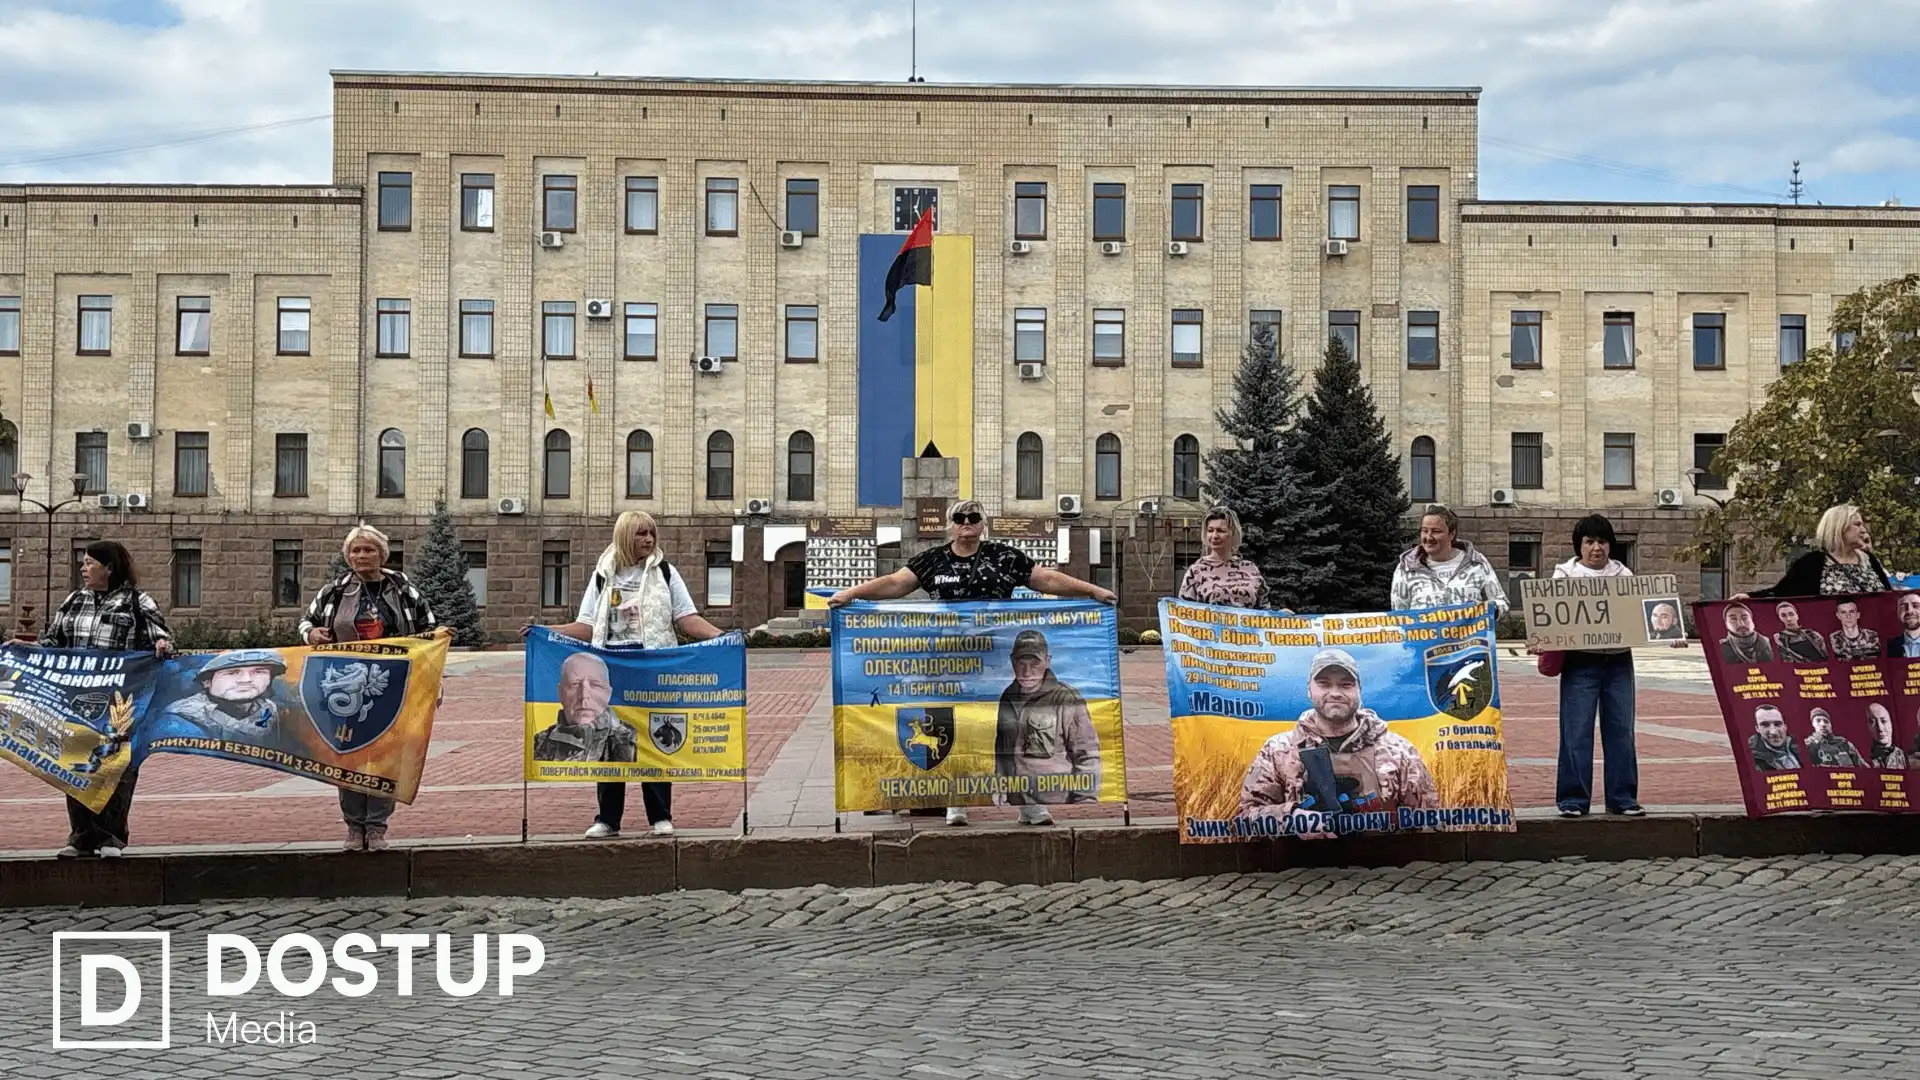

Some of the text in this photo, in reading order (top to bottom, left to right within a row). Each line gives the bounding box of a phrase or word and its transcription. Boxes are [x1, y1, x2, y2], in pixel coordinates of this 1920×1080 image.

[1524, 578, 1611, 599] НАЙБІЛЬША
[900, 611, 960, 628] ЗНИКЛИЙ
[975, 612, 990, 626] НЕ
[994, 612, 1046, 626] ЗНАЧИТЬ
[1168, 602, 1238, 626] Безвісти
[1323, 618, 1343, 630] не
[1346, 615, 1414, 630] значить
[1532, 600, 1611, 627] ВОЛЯ
[1169, 617, 1491, 647] Кохаю, Вірю, Чекаю, Поверніть моє серце!
[316, 643, 380, 653] 04.11.1993
[852, 635, 993, 654] СПОДИНЮК МИКОЛА
[1206, 647, 1276, 664] Олександр
[864, 658, 983, 676] ОЛЕКСАНДРОВИЧ
[1181, 654, 1266, 677] Миколайович
[43, 670, 126, 688] Іванович
[657, 674, 719, 686] ПЛАСОВЕНКО
[623, 690, 681, 703] ВОЛОДИМИР
[888, 682, 961, 697] 141 БРИГАДА
[1188, 690, 1264, 717] «Маріо»
[1438, 724, 1496, 737] 57 бригада
[1434, 741, 1445, 752] 17
[150, 738, 221, 750] ЗНИКЛИЙ
[224, 742, 293, 766] БЕЗВІСТИ
[304, 760, 380, 788] 24.08.2025
[539, 767, 589, 777] ПОВЕРТАЙСЯ
[591, 767, 621, 777] ЖИВИМ
[881, 772, 1096, 799] ЧЕКАЄМО, ШУКАЄМО, ВІРИМО!
[1185, 806, 1513, 838] Зник 11.10.2025 року, Вовчанськ
